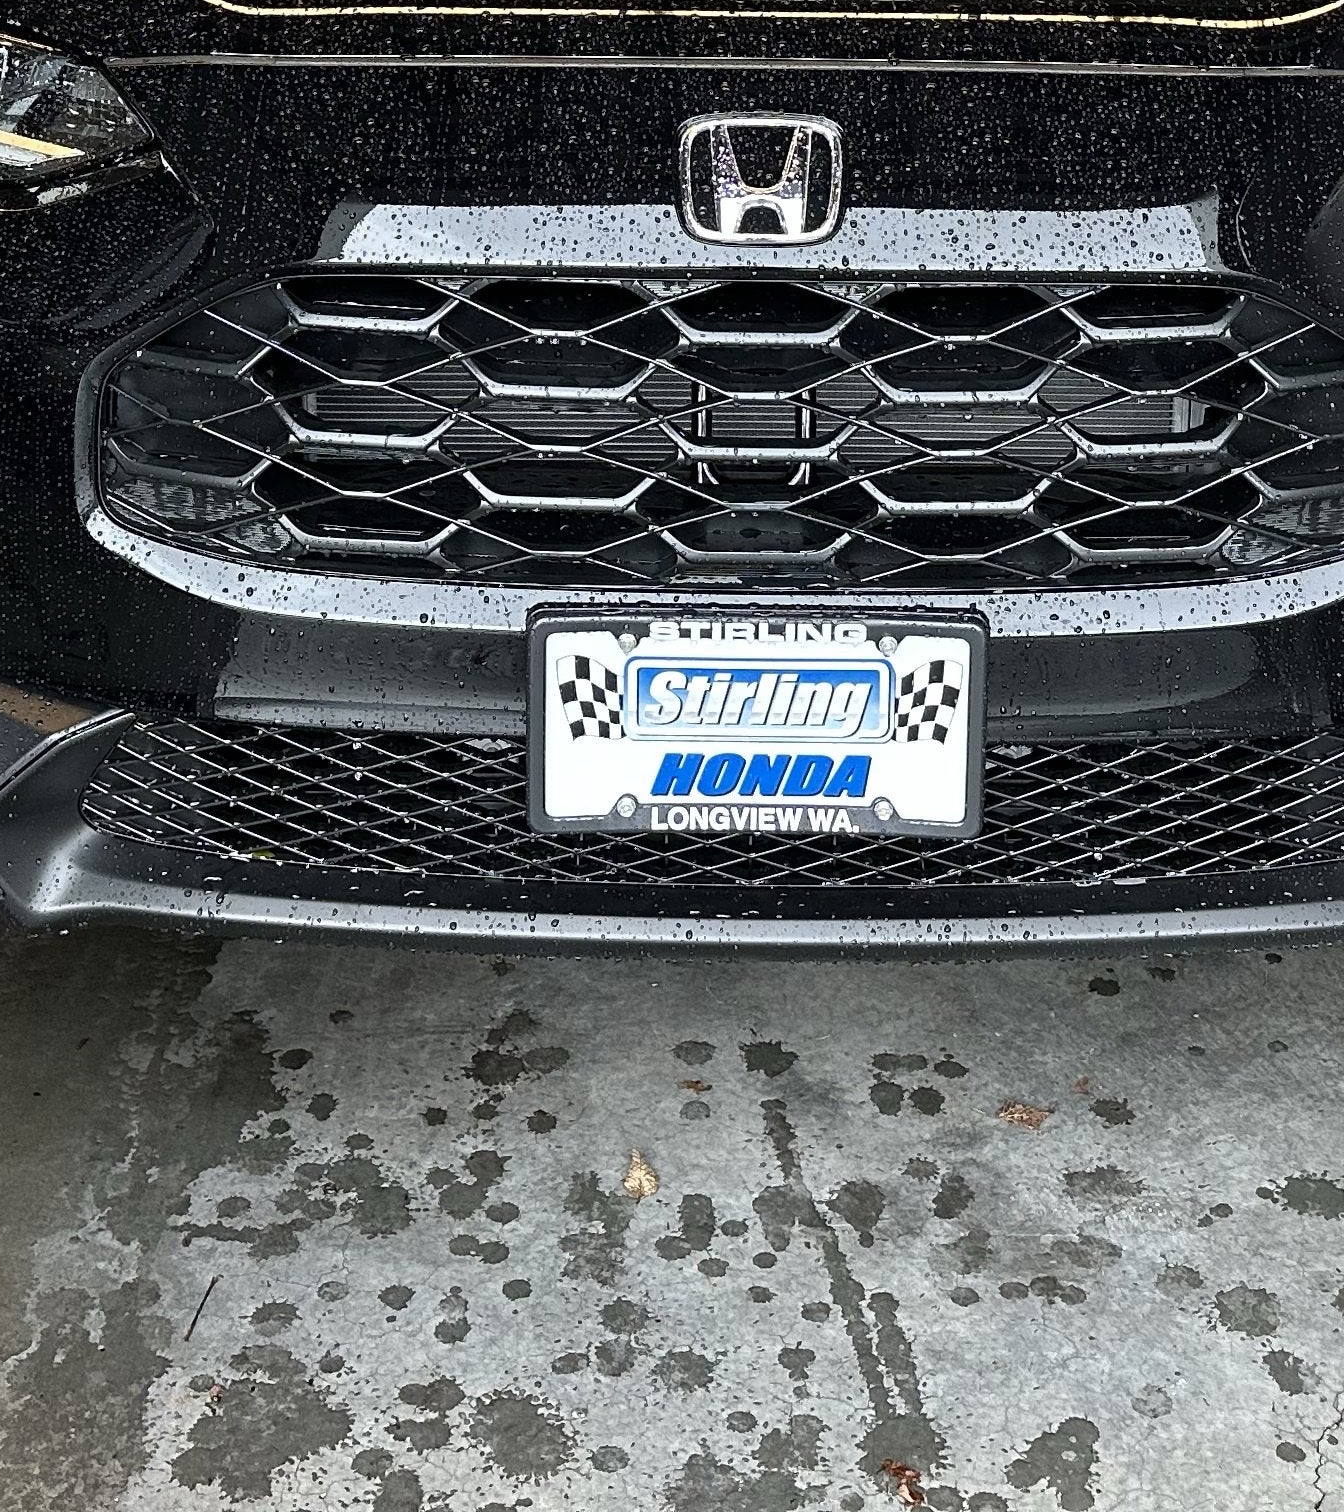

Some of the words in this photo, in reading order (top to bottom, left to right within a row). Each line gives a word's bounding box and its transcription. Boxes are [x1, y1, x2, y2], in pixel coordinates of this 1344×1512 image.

[648, 621, 868, 644] STIRLING
[643, 670, 873, 738] Stirling
[650, 752, 873, 797] HONDA
[650, 806, 804, 832] LONGVIEW
[807, 808, 860, 834] WA.
